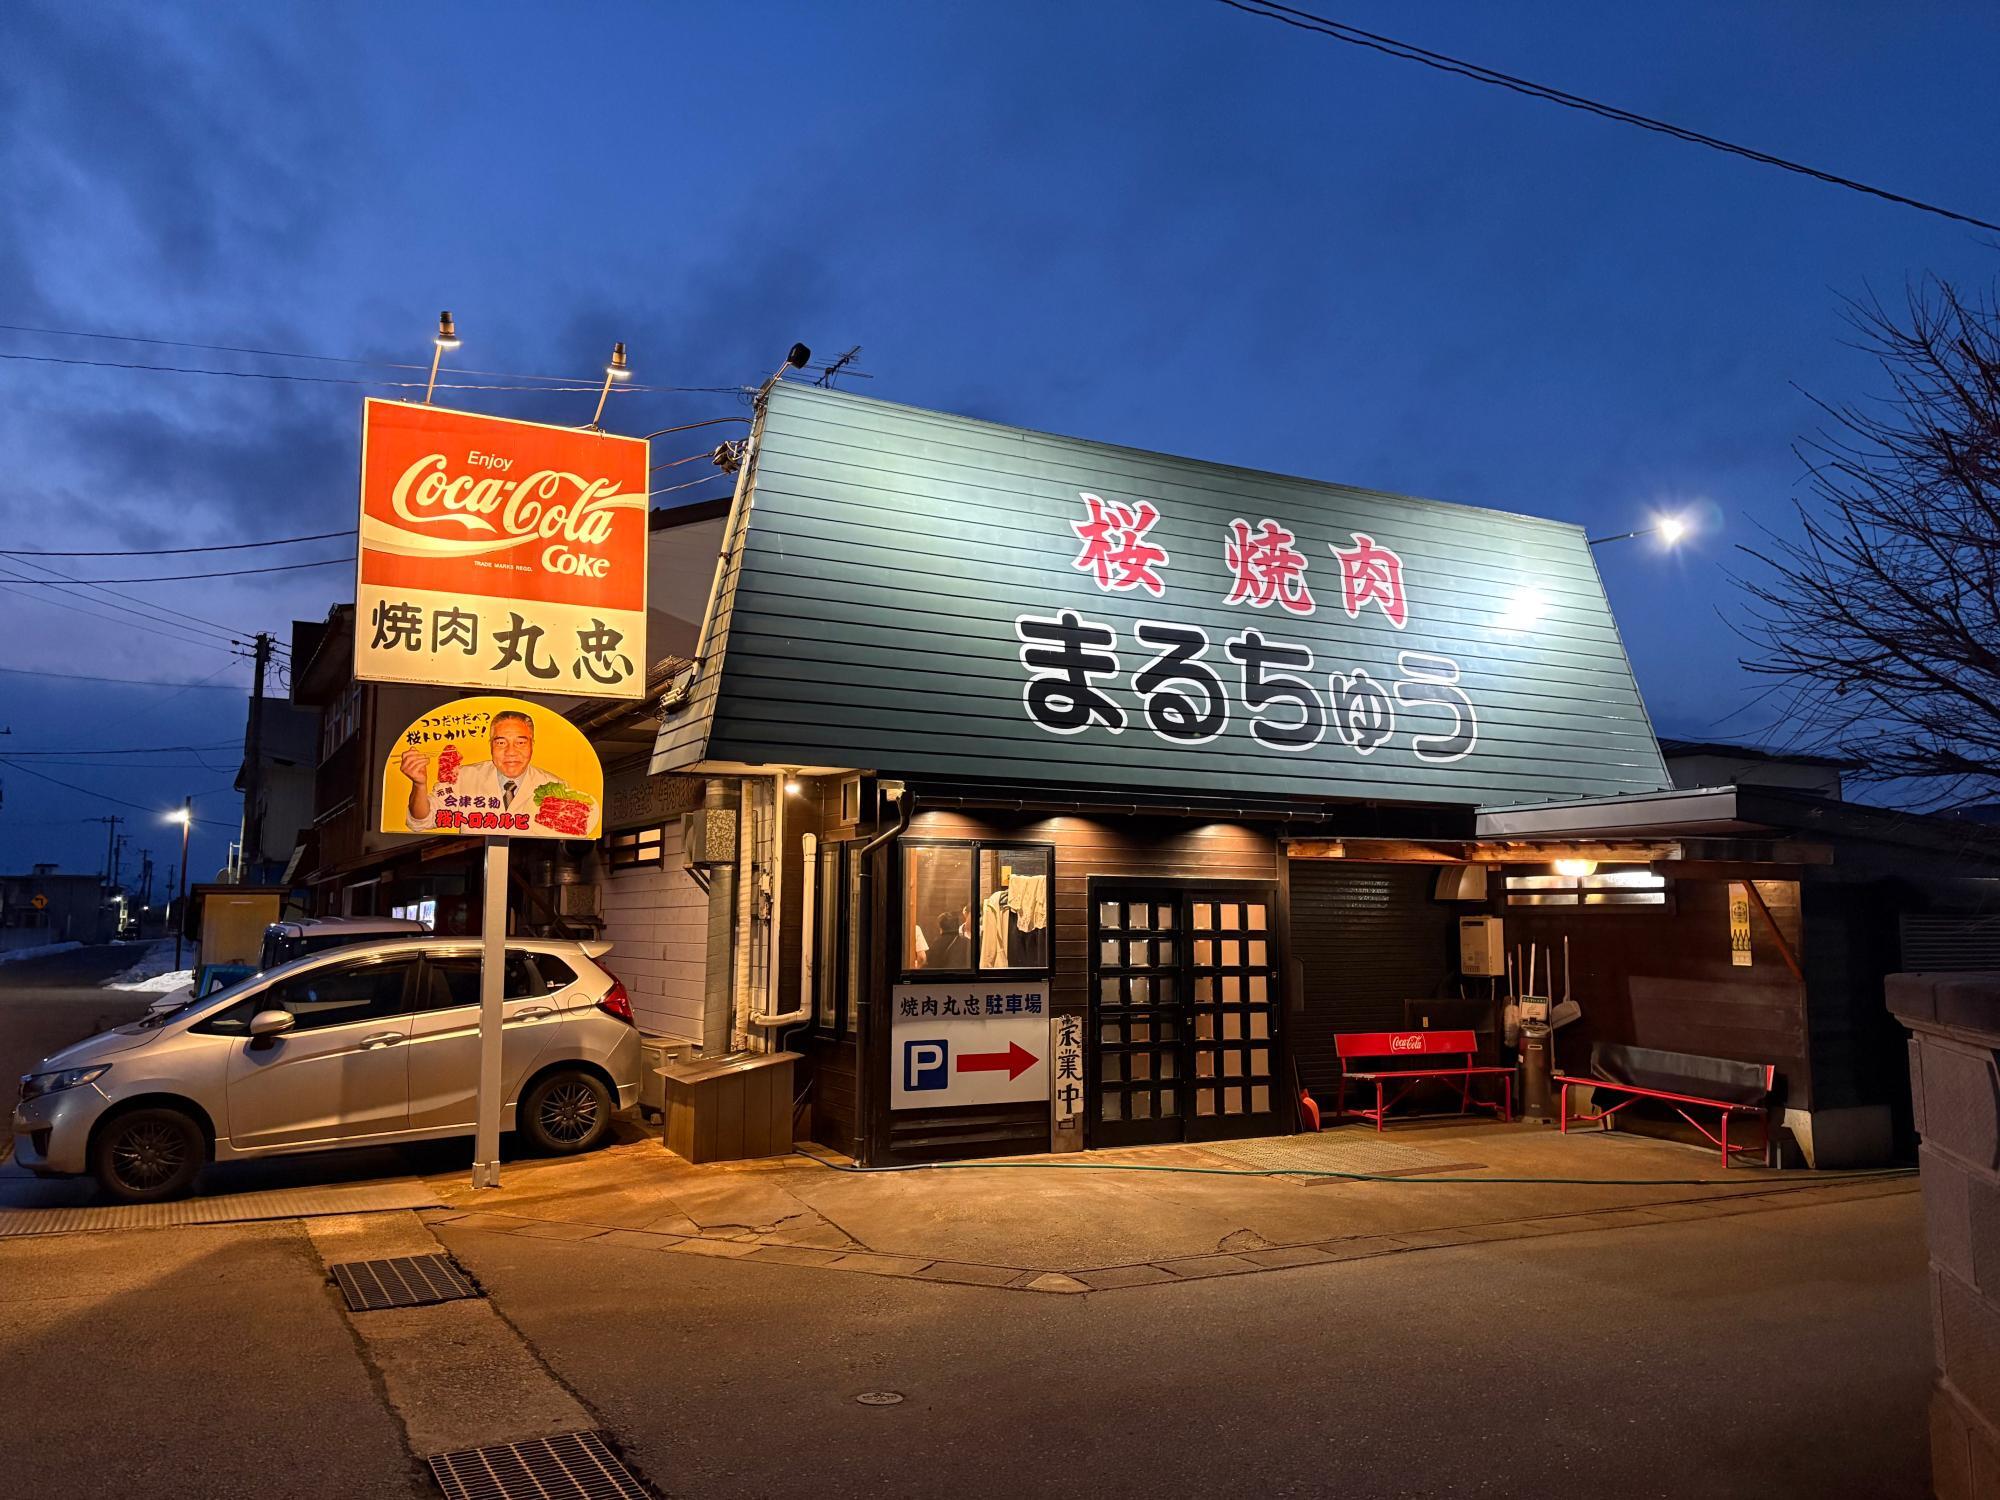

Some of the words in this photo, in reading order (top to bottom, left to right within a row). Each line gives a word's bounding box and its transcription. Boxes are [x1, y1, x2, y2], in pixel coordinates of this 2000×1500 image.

[468, 450, 513, 471] Enjoy
[392, 453, 622, 545] Coca-Cola
[541, 545, 611, 578] Coke
[1015, 608, 1479, 763] まるちゅう
[444, 795, 501, 809] 会津名物
[436, 809, 530, 830] 桜トロカルビ
[1392, 1035, 1422, 1051] Coca-Cola
[910, 1044, 943, 1087] P
